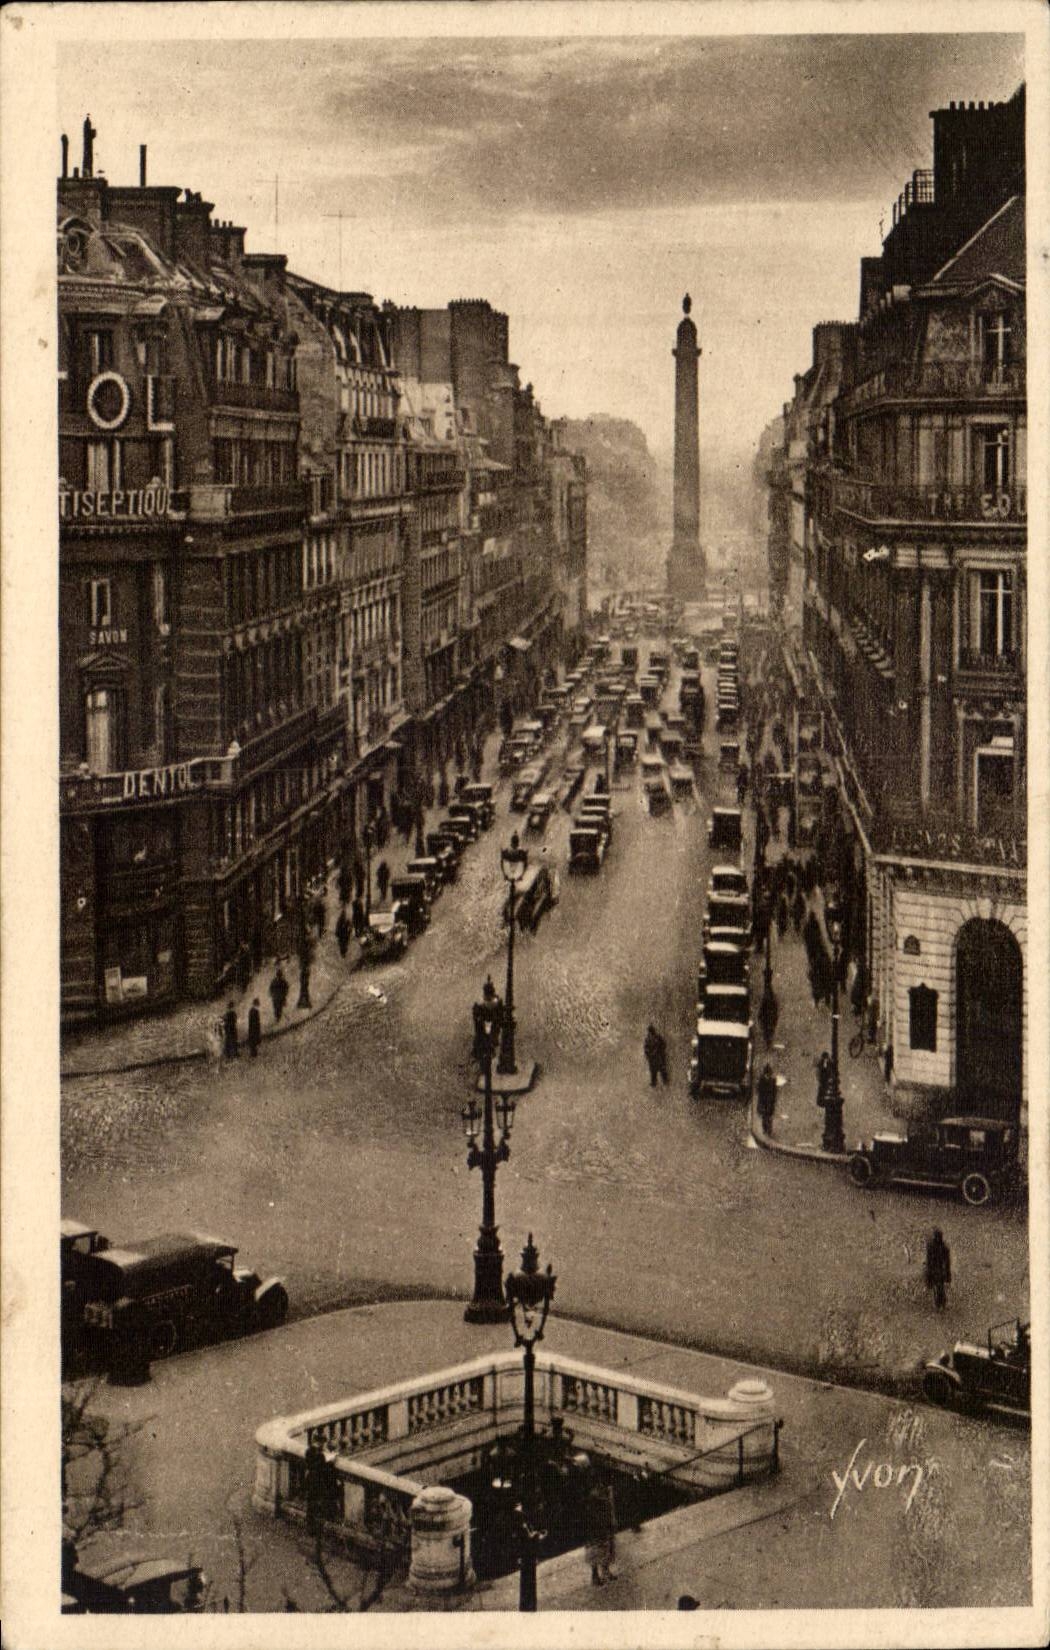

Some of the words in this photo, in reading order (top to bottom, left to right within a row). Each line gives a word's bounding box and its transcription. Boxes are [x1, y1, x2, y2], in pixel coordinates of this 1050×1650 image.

[58, 370, 175, 431] OL
[89, 628, 128, 645] SAVON
[123, 765, 202, 799] DENTOL
